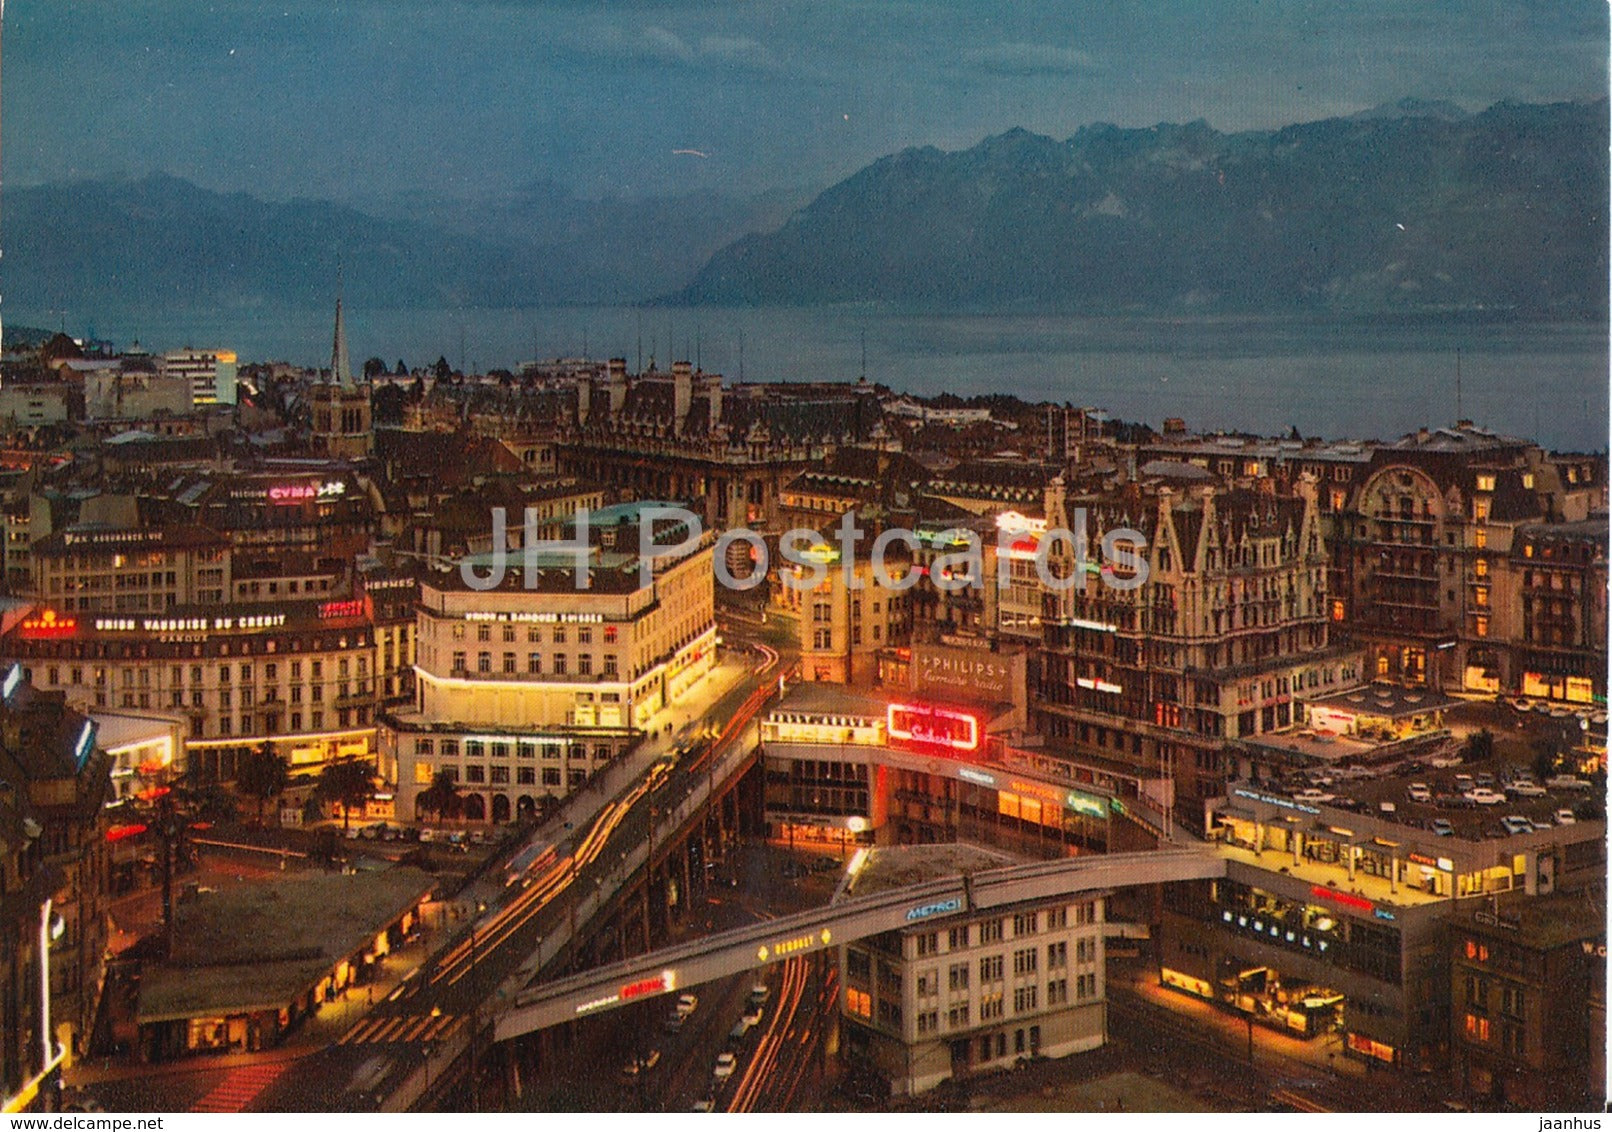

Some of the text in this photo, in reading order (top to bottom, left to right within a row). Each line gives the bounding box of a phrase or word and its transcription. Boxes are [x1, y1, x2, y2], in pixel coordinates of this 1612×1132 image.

[269, 486, 315, 500] CYMA
[365, 578, 416, 591] HERMES
[96, 619, 136, 631] UNION
[144, 618, 208, 631] VAUDOISE
[215, 617, 233, 630] DU
[160, 633, 208, 643] BANQUE
[933, 657, 995, 677] PHILIPS
